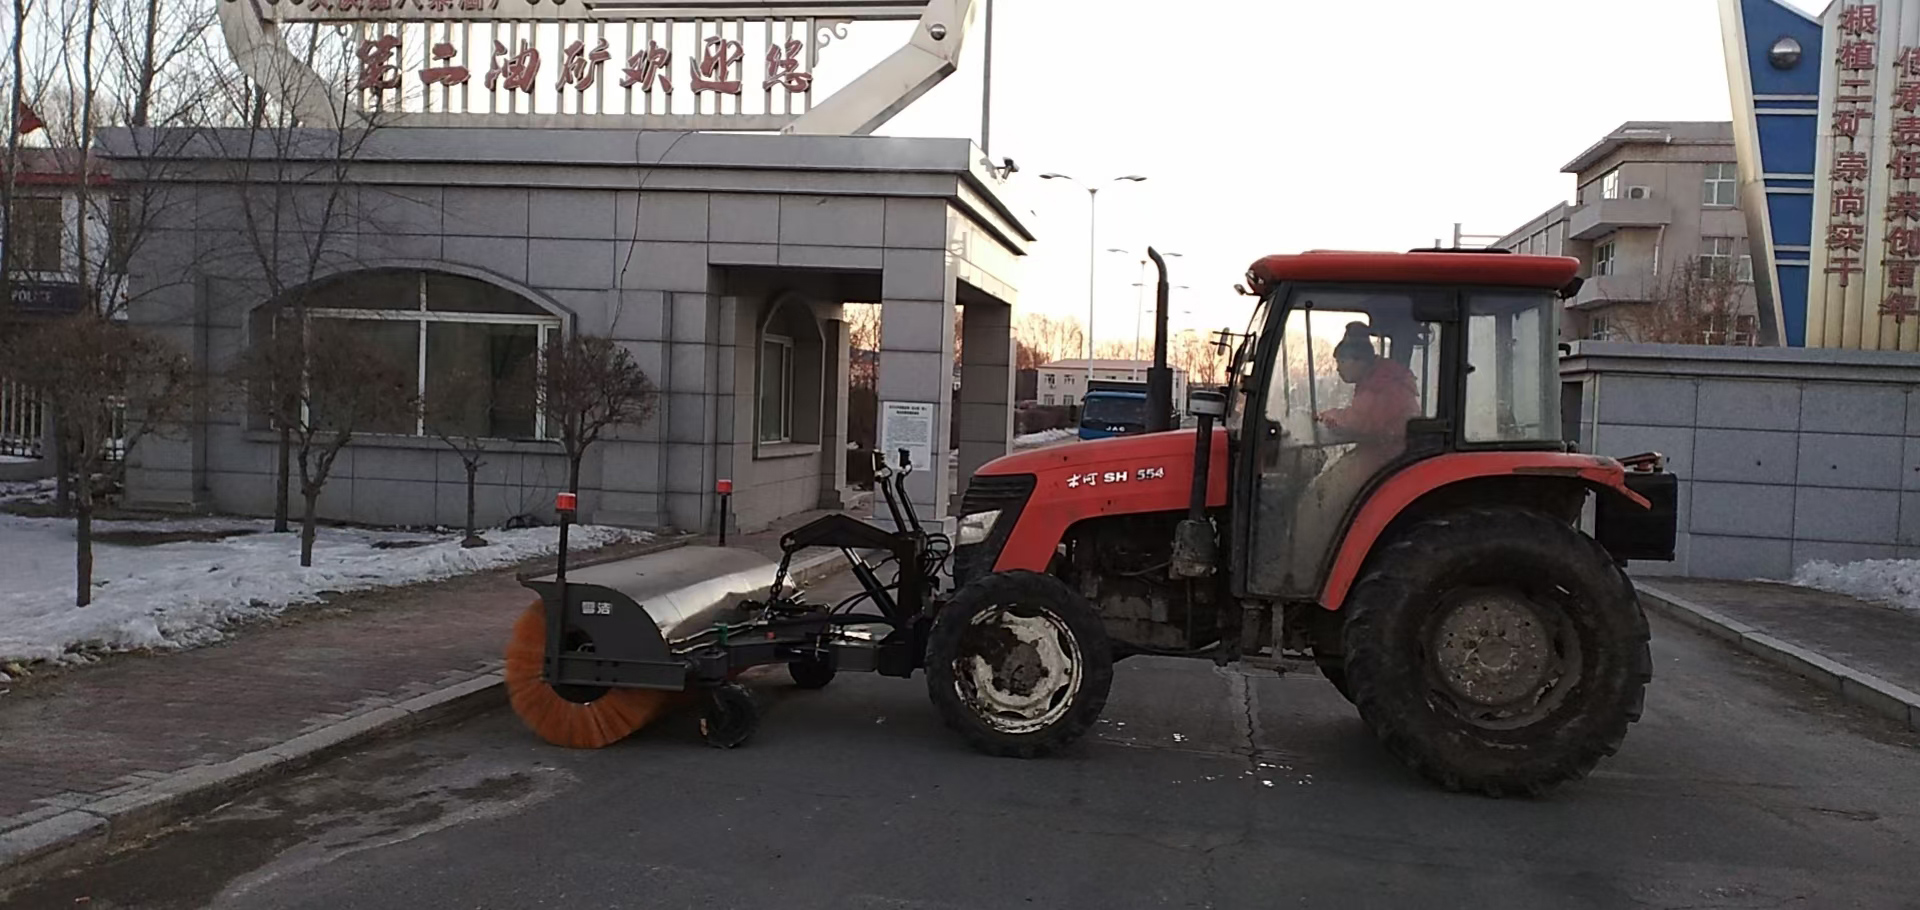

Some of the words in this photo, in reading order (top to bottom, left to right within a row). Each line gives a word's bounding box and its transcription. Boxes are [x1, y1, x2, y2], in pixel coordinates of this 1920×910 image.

[357, 34, 813, 94] 第二油矿欢迎您
[1103, 471, 1128, 483] SH
[1137, 467, 1165, 480] 554
